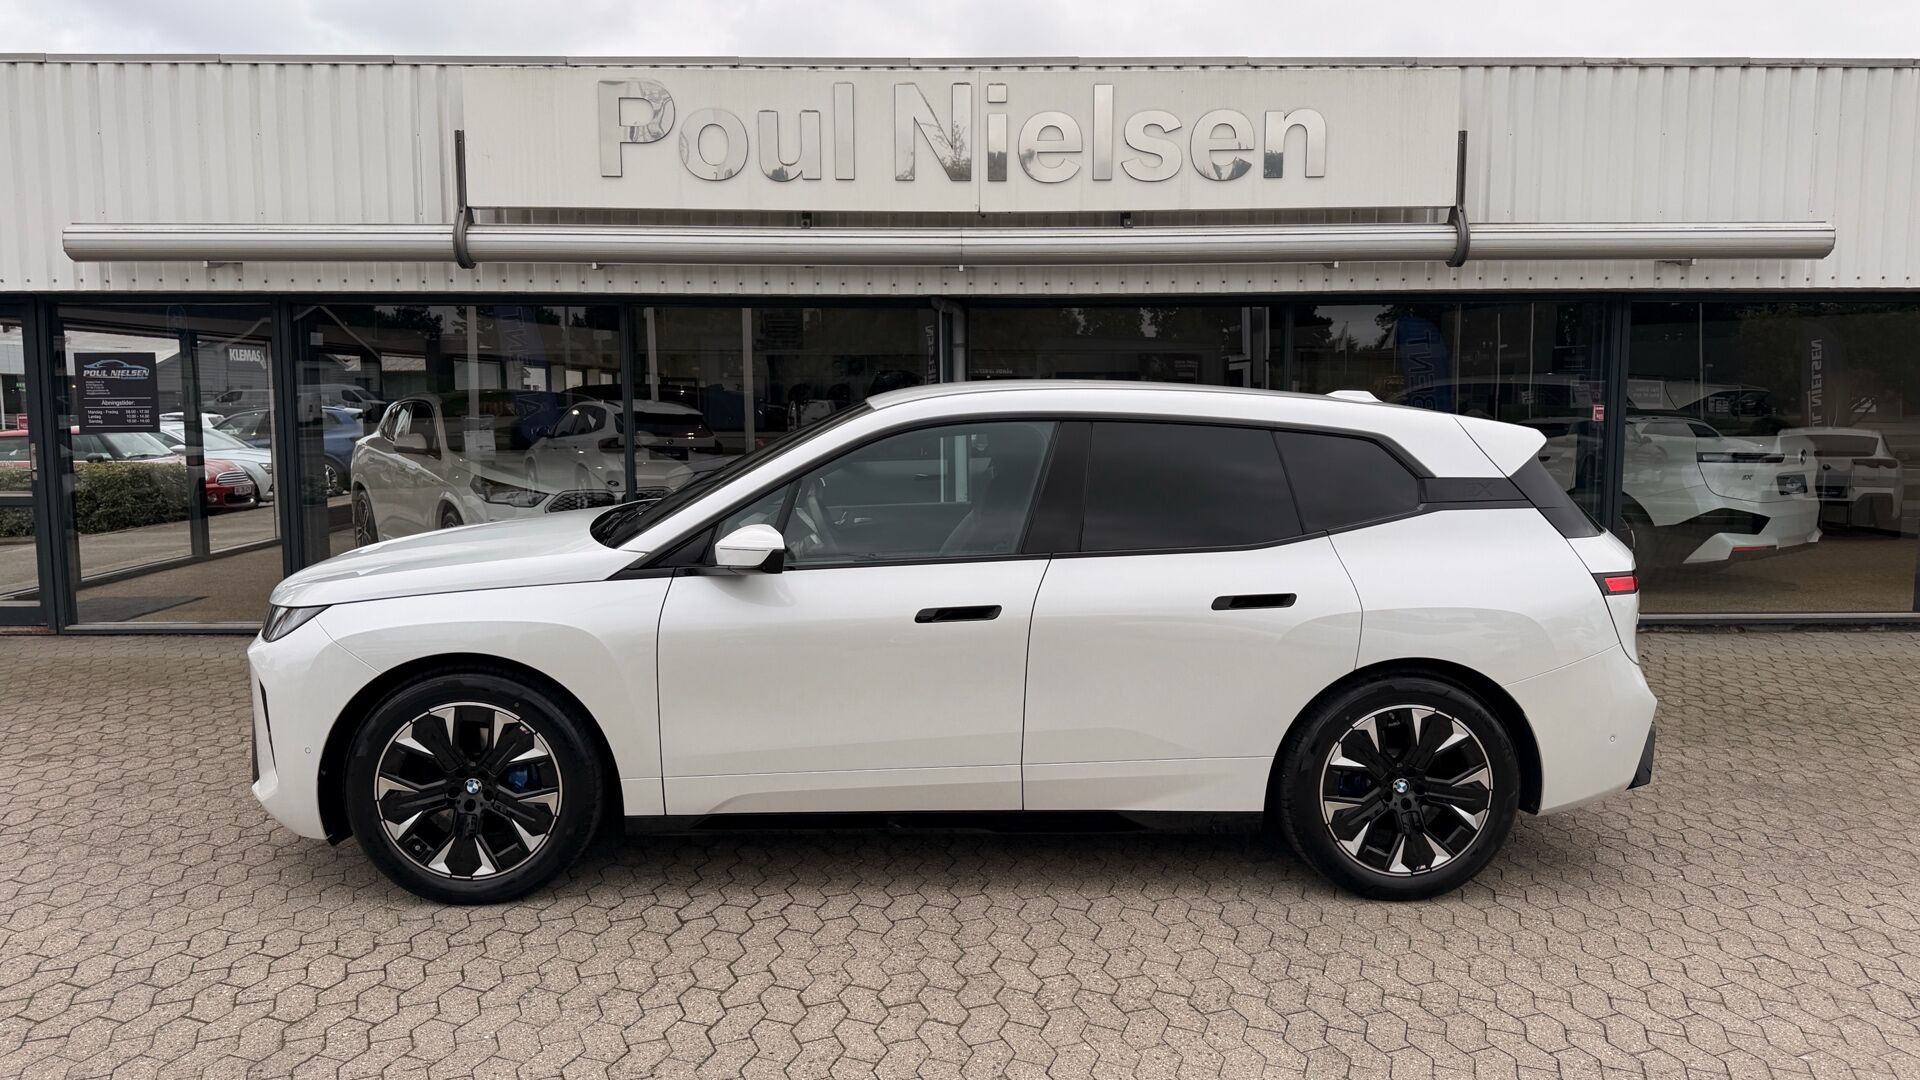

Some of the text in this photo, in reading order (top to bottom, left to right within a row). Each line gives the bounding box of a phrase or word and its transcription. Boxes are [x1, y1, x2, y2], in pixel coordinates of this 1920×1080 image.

[596, 79, 1327, 184] Poul Nielsen
[229, 348, 261, 362] KLEMAS
[83, 369, 149, 377] POUL NIELSEN
